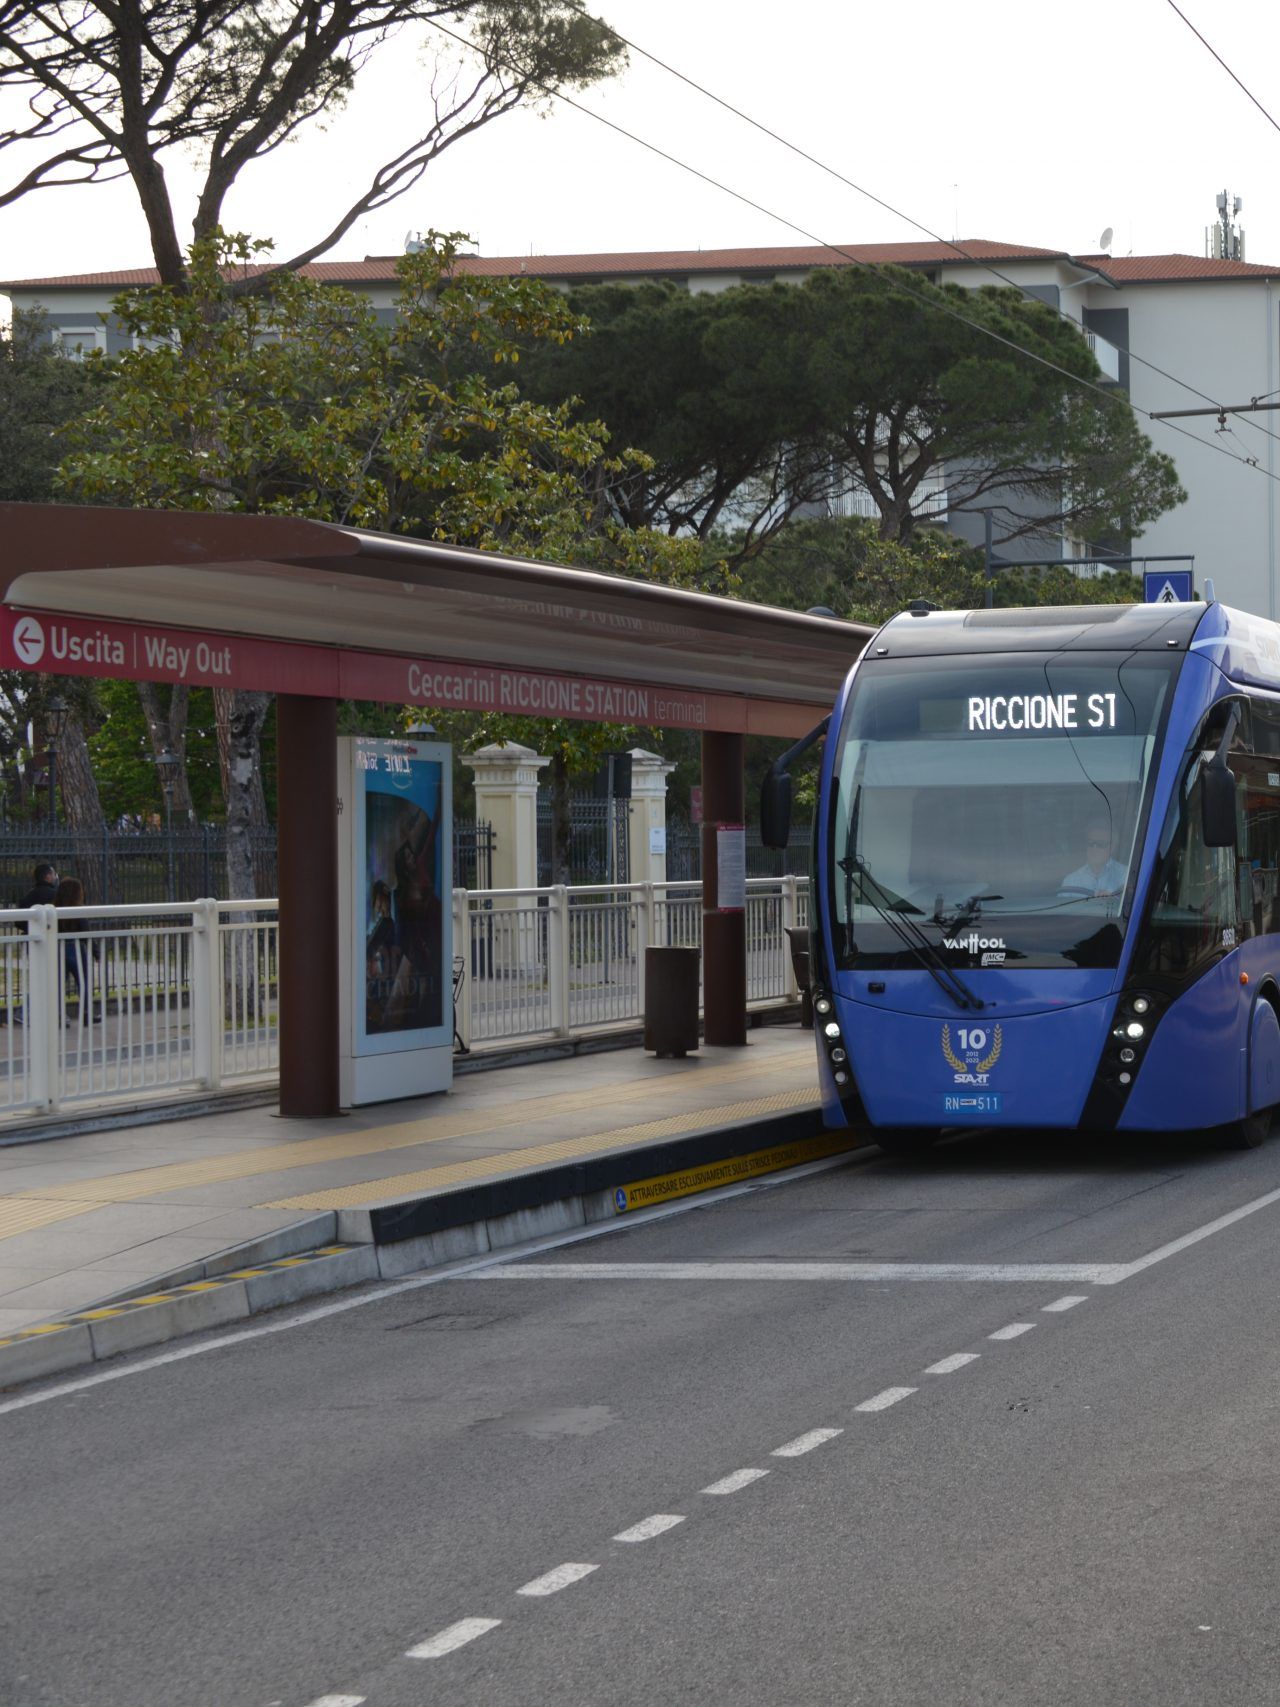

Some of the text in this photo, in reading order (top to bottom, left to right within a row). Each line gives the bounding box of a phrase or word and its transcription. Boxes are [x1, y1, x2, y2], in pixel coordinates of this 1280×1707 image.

[51, 626, 232, 678] Uscita Way Out
[408, 663, 708, 724] Ceccarini RICCIONE STATION terminal
[968, 694, 1078, 731] RICCIONE
[953, 1073, 990, 1083] START
[945, 1097, 960, 1110] RN
[978, 1097, 998, 1111] 511
[630, 1181, 678, 1202] ATTRAVERSARE
[678, 1166, 733, 1191] ESCLUSIVAMENTE
